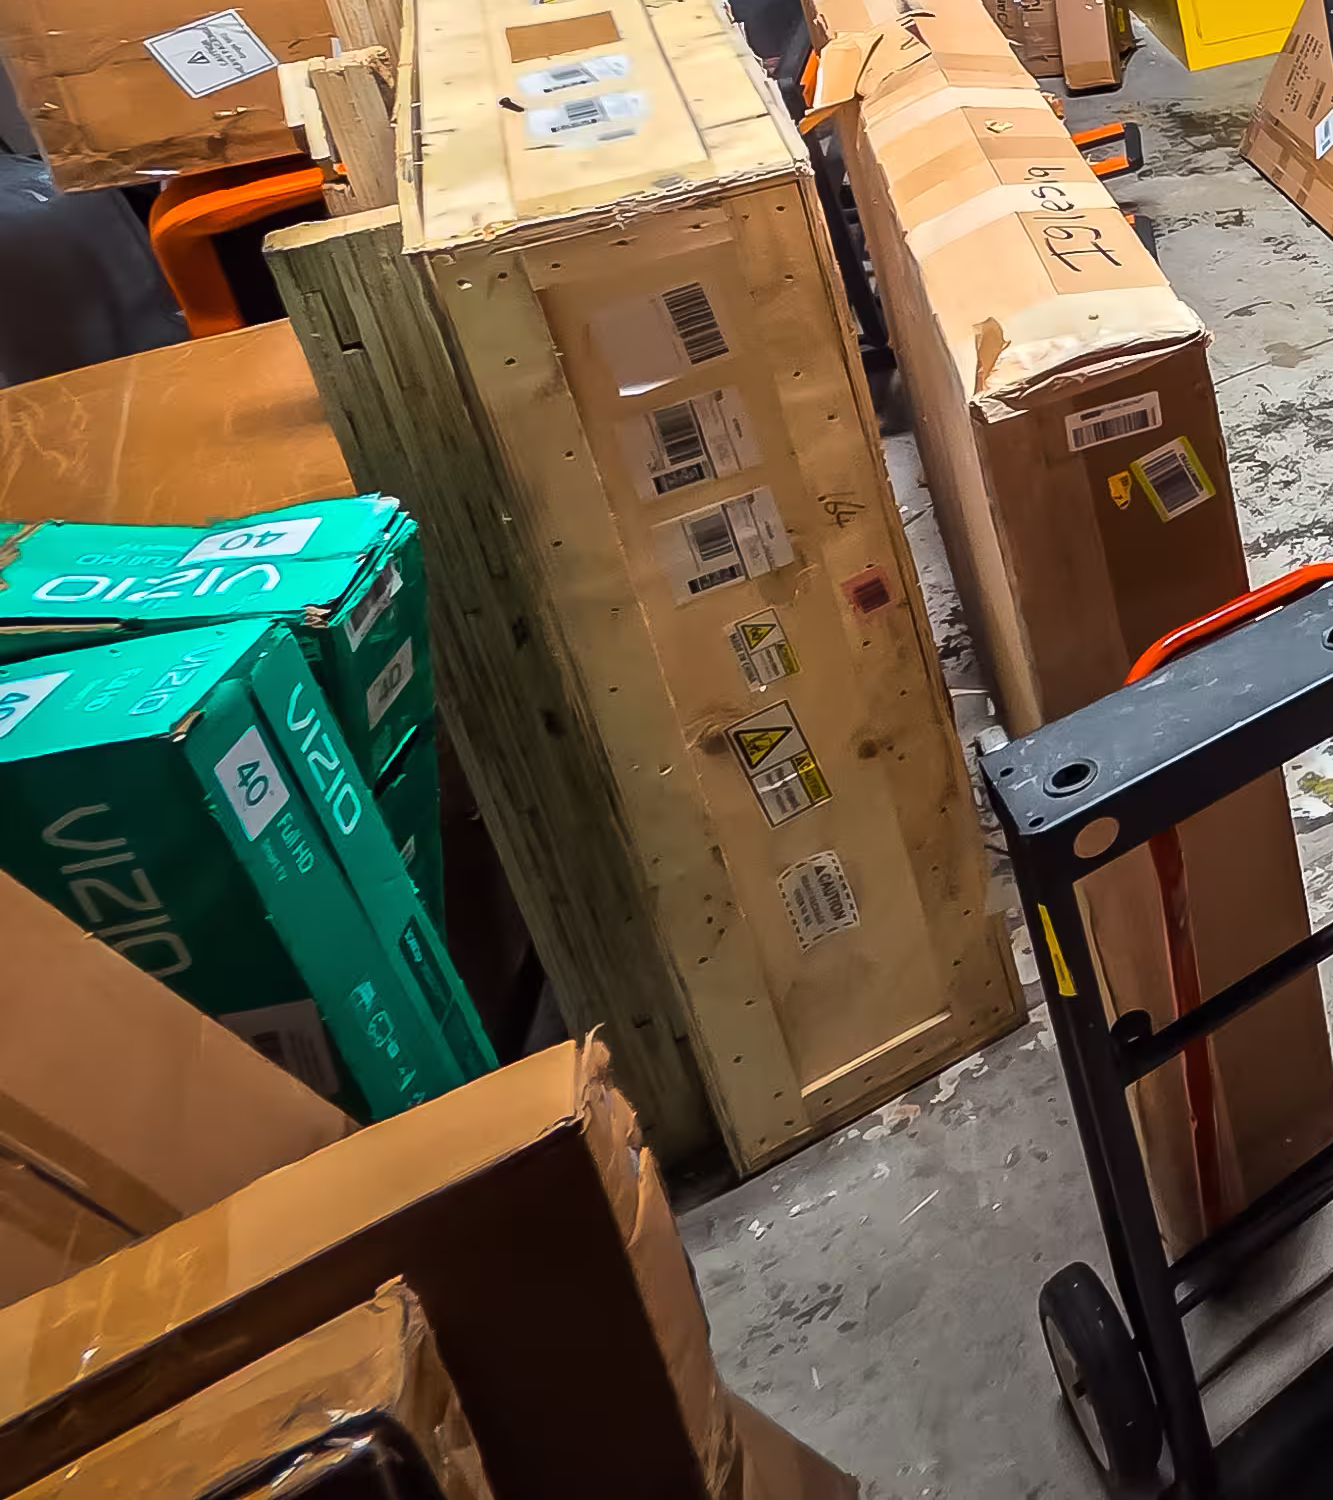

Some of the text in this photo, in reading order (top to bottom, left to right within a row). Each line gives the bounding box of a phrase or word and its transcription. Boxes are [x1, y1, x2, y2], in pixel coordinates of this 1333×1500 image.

[217, 530, 288, 550] 40
[32, 563, 282, 603] VIZIO
[129, 642, 220, 716] VIZIO
[234, 760, 271, 807] 40
[286, 683, 362, 835] VIZIO
[276, 812, 315, 875] Full HD
[42, 802, 192, 980] VIZIO
[818, 873, 847, 922] CAUTION
